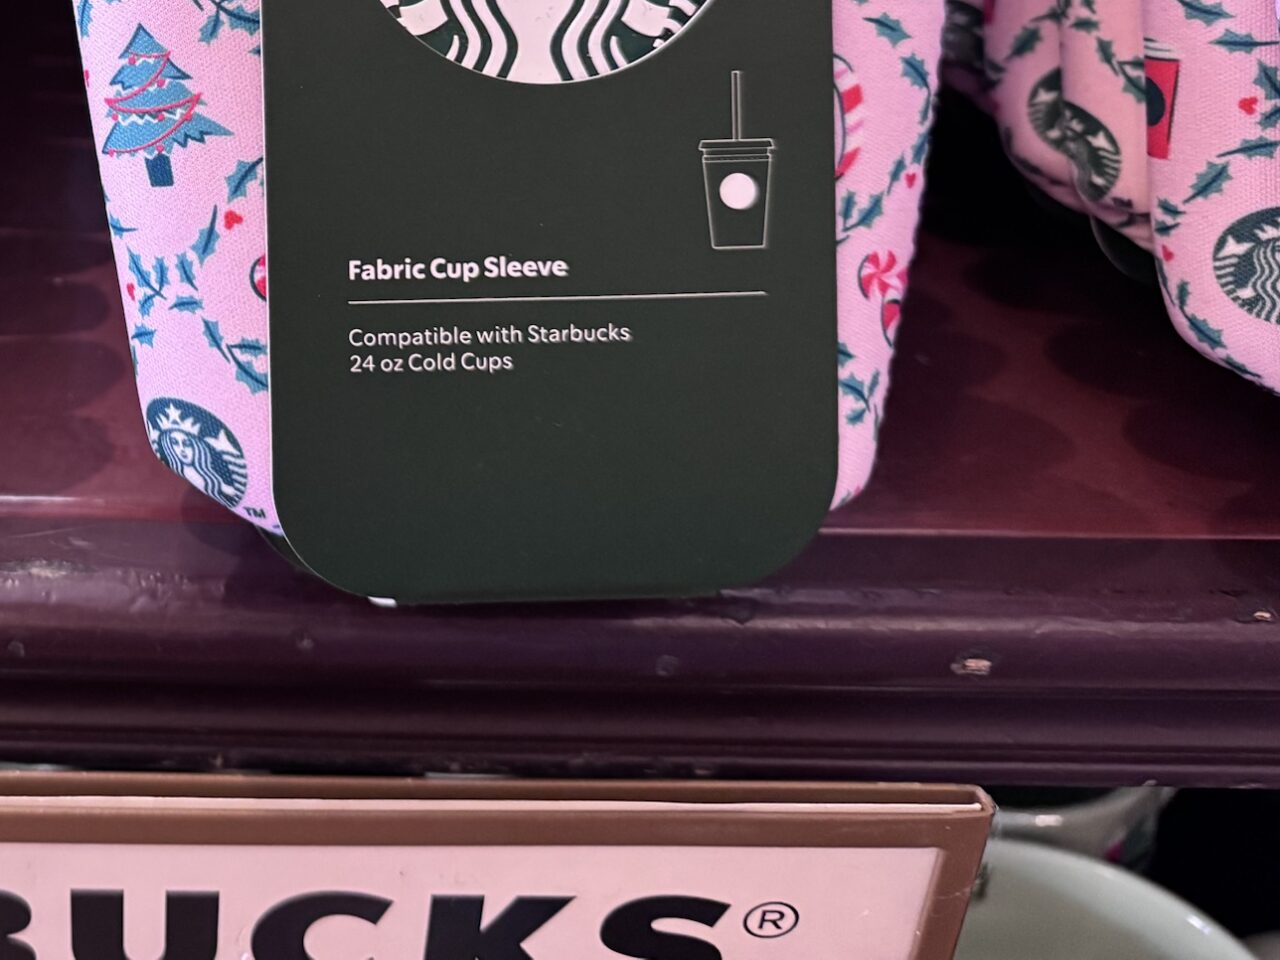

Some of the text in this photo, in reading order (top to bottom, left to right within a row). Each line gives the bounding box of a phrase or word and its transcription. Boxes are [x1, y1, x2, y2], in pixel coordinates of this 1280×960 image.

[348, 255, 570, 282] Fabric Cup Sleeve
[348, 322, 633, 349] Compatible with Starbucks
[350, 351, 514, 374] 24 oz Cold Cups
